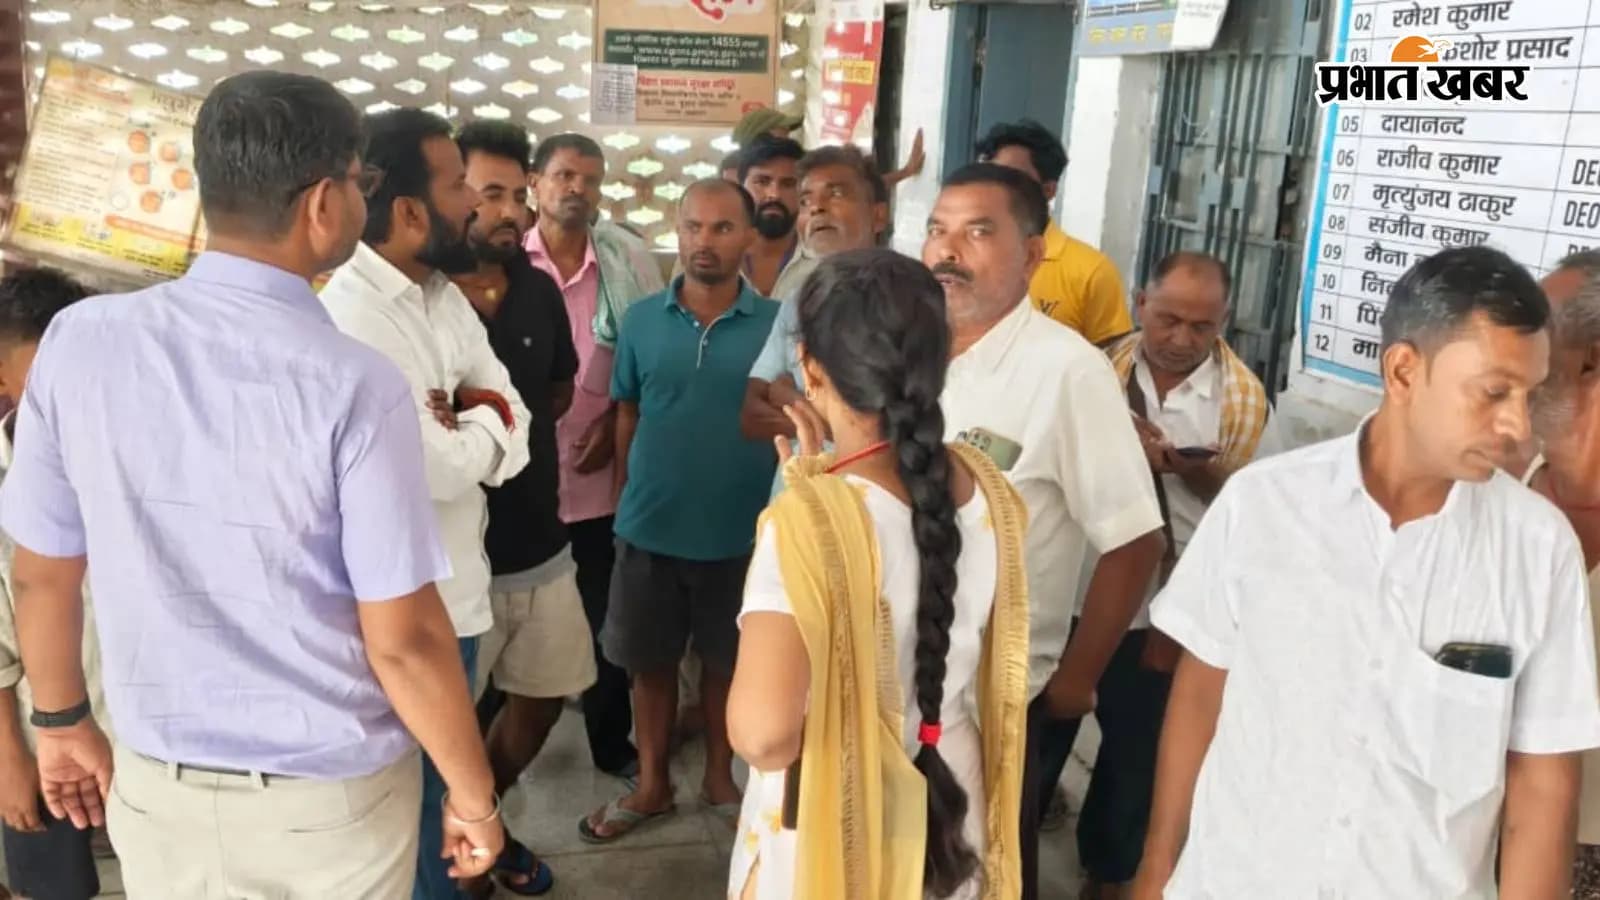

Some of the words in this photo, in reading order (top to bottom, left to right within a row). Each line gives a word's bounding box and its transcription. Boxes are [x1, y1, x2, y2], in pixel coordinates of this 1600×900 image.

[1354, 14, 1372, 30] 02
[1392, 5, 1440, 28] रमेश
[1447, 1, 1512, 29] कुमार
[711, 36, 740, 47] 14555
[1350, 48, 1368, 62] 03
[1442, 34, 1499, 61] कशोर
[1506, 37, 1573, 61] प्रसाद
[1342, 116, 1359, 132] 05
[1381, 114, 1466, 135] दायानन्द
[1337, 150, 1354, 166] 06
[1376, 145, 1433, 171] राजीव
[1438, 153, 1502, 179] कुमार
[1572, 158, 1600, 186] DE
[1332, 183, 1350, 201] 07
[1372, 183, 1452, 211] मृत्युंजय
[1457, 192, 1517, 221] ठाकुर
[1563, 200, 1600, 229] DEO
[1328, 214, 1346, 231] 08
[1367, 213, 1426, 239] संजीव
[1431, 224, 1490, 249] कुमार
[1323, 243, 1342, 260] 09
[1364, 240, 1408, 268] मैना
[1322, 274, 1336, 289] 10
[1320, 303, 1331, 320] 11
[1356, 301, 1384, 326] पिं
[1315, 334, 1330, 352] 12
[1352, 337, 1381, 360] मा
